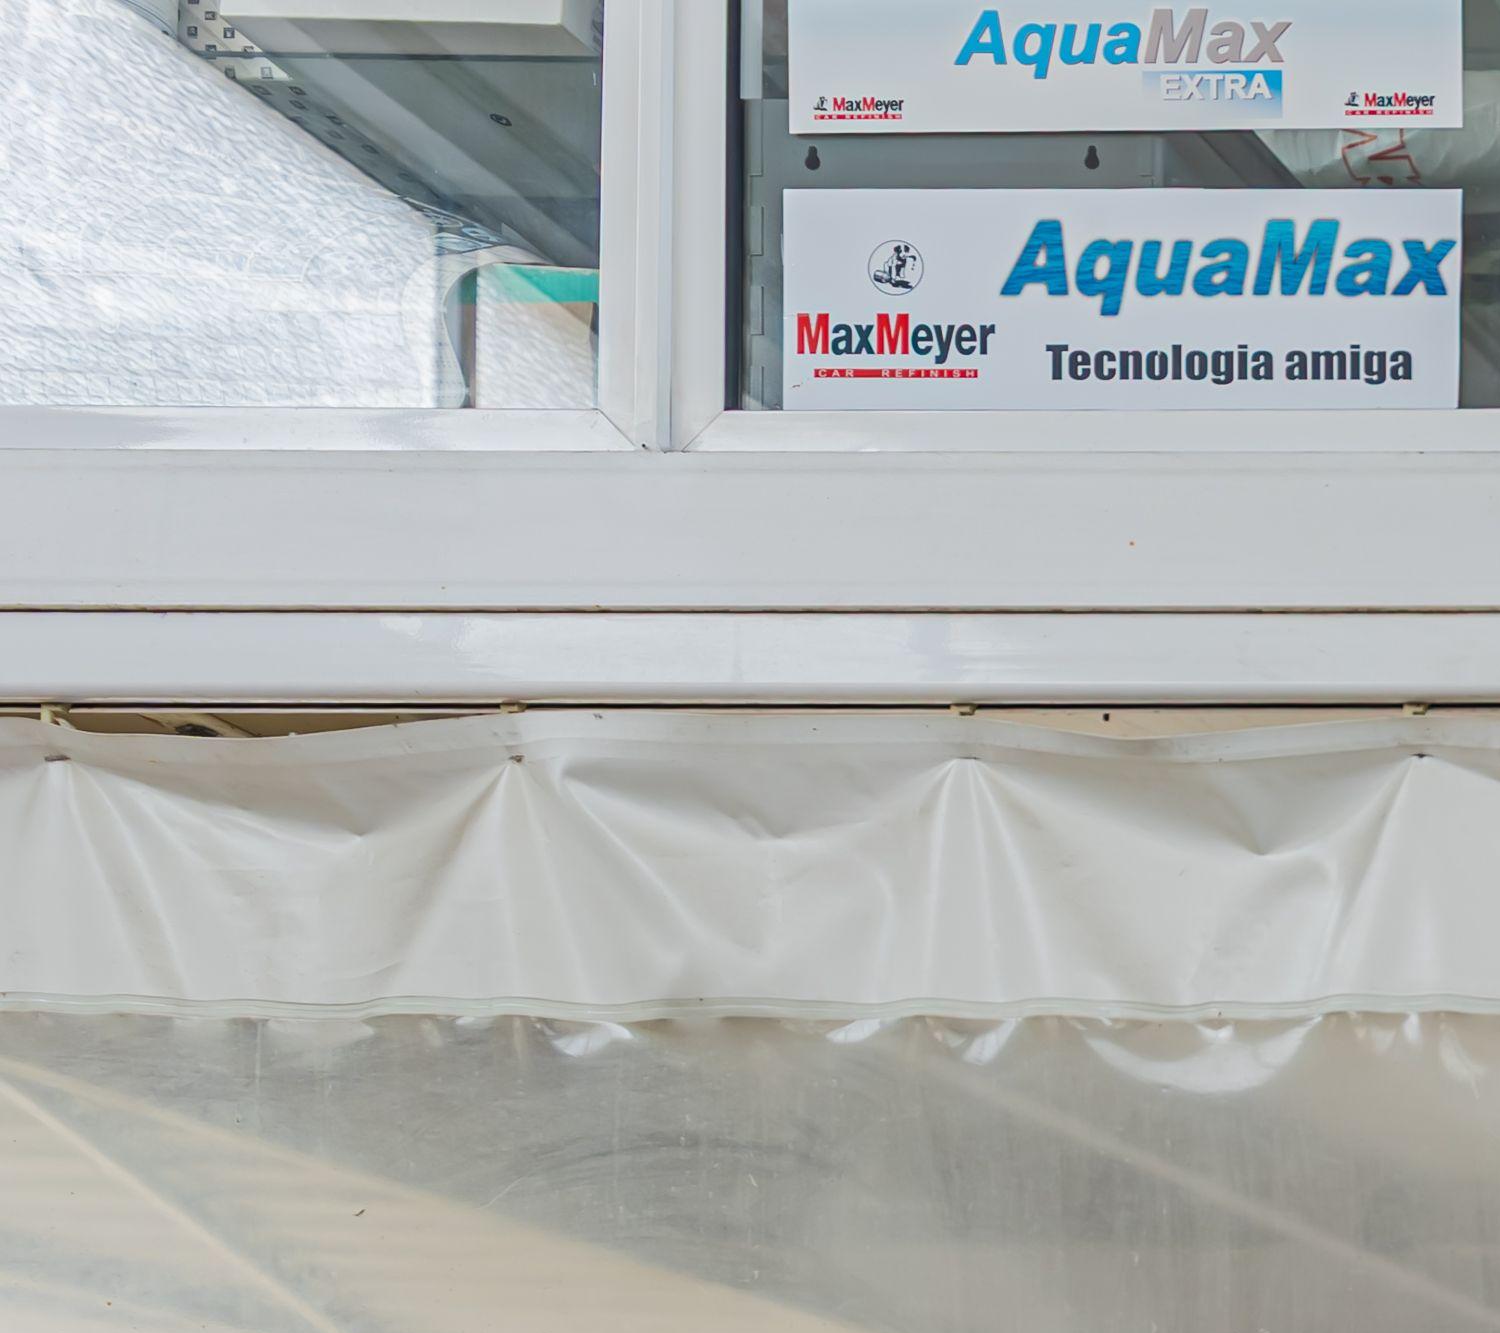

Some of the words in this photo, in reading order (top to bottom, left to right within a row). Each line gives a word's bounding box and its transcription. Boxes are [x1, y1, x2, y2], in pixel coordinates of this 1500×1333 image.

[954, 8, 1294, 79] AquaMax
[832, 97, 904, 113] MaxMeyer
[1160, 73, 1272, 102] EXTRA
[1364, 92, 1435, 109] MaxMeyer
[1000, 219, 1458, 317] AquaMax
[796, 313, 996, 364] MaxMeyer
[818, 369, 855, 378] CAR
[881, 369, 976, 378] REFINISH
[1046, 343, 1277, 386] Tecnologia
[1285, 342, 1413, 386] amiga
